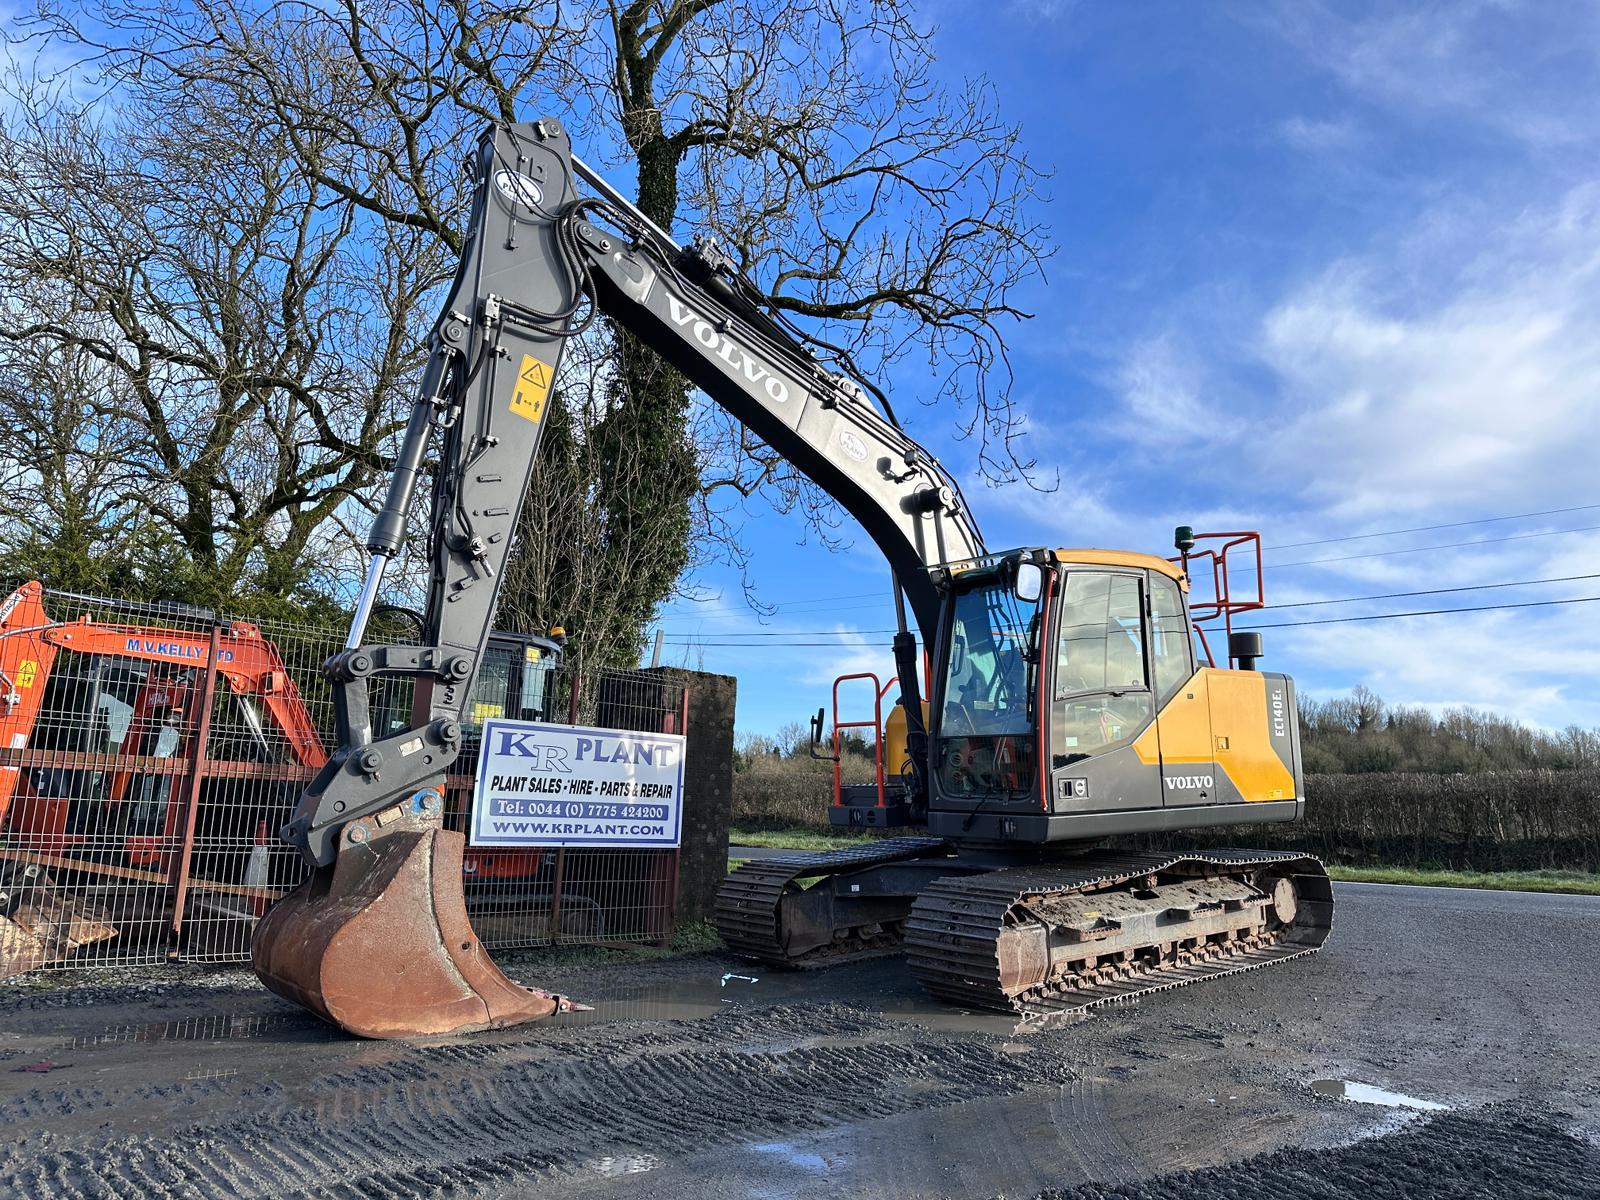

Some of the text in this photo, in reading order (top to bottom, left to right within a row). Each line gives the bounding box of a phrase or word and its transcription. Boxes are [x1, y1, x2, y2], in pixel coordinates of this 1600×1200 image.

[665, 292, 790, 403] VOLVO
[575, 737, 674, 767] PLANT
[491, 775, 528, 792] PLANT
[528, 777, 563, 794] SALES
[568, 779, 594, 795] HIRE
[599, 781, 631, 797] PARTS
[631, 782, 639, 797] &
[639, 783, 673, 799] REPAIR
[1164, 775, 1214, 790] VOLVO
[497, 799, 664, 818] Tel: 0044 (0) 7775 424200
[493, 821, 665, 836] WWW.KRPLANT.COM
